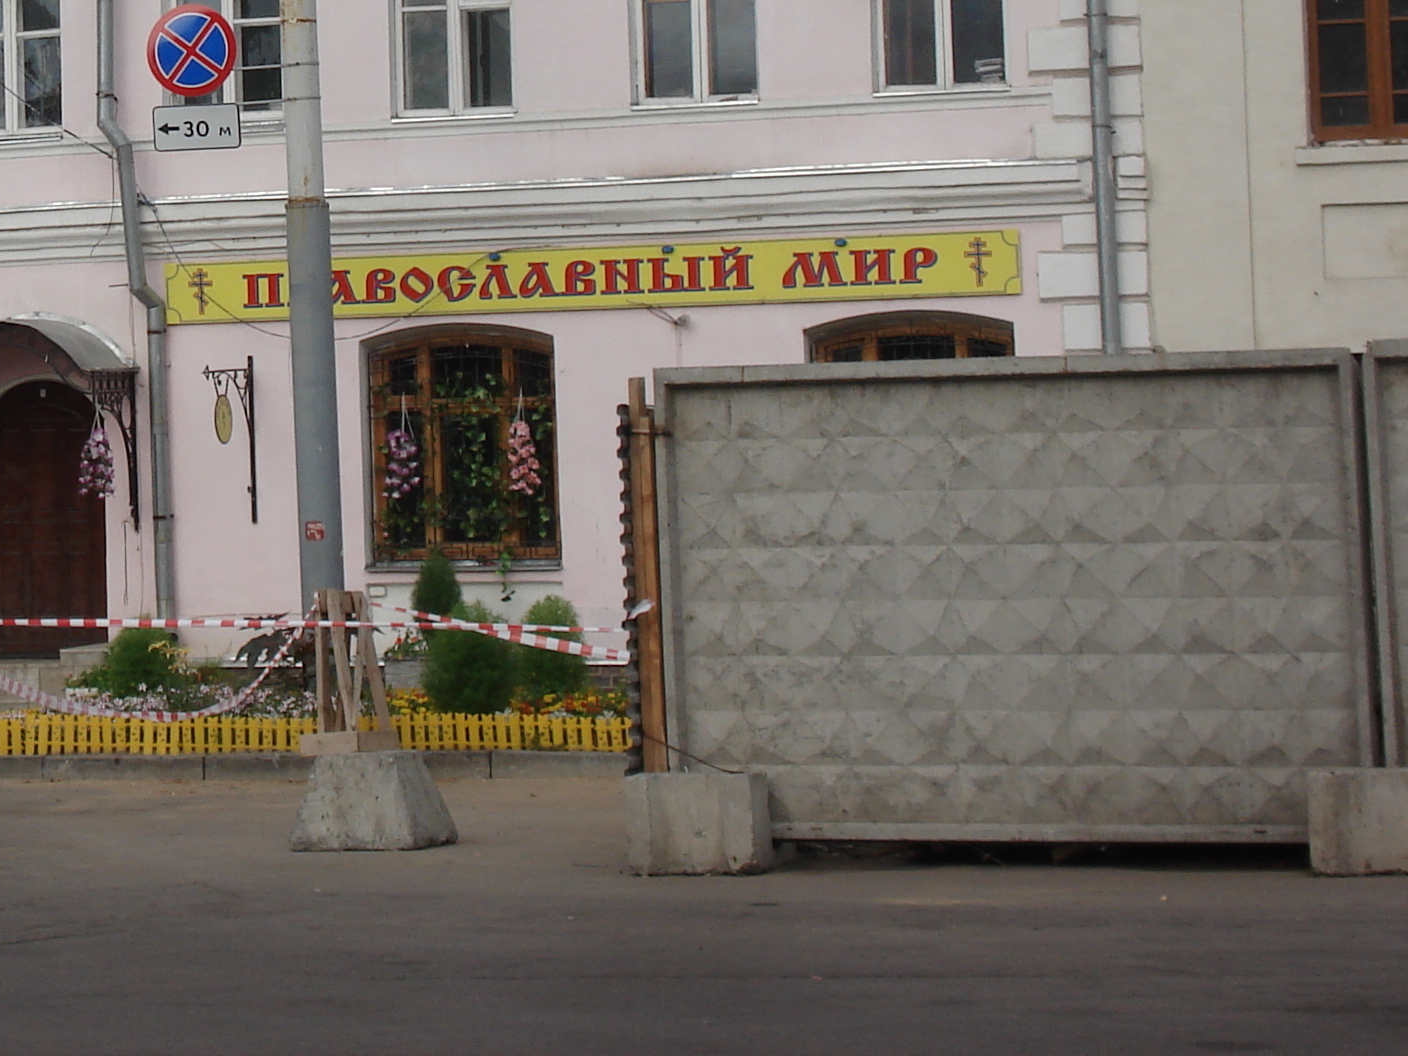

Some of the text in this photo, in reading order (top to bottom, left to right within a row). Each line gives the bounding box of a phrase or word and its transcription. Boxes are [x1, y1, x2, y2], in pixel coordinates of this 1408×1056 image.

[183, 121, 210, 138] 30
[242, 246, 938, 309] ПАВОСЛАВНЫЙ МИР
